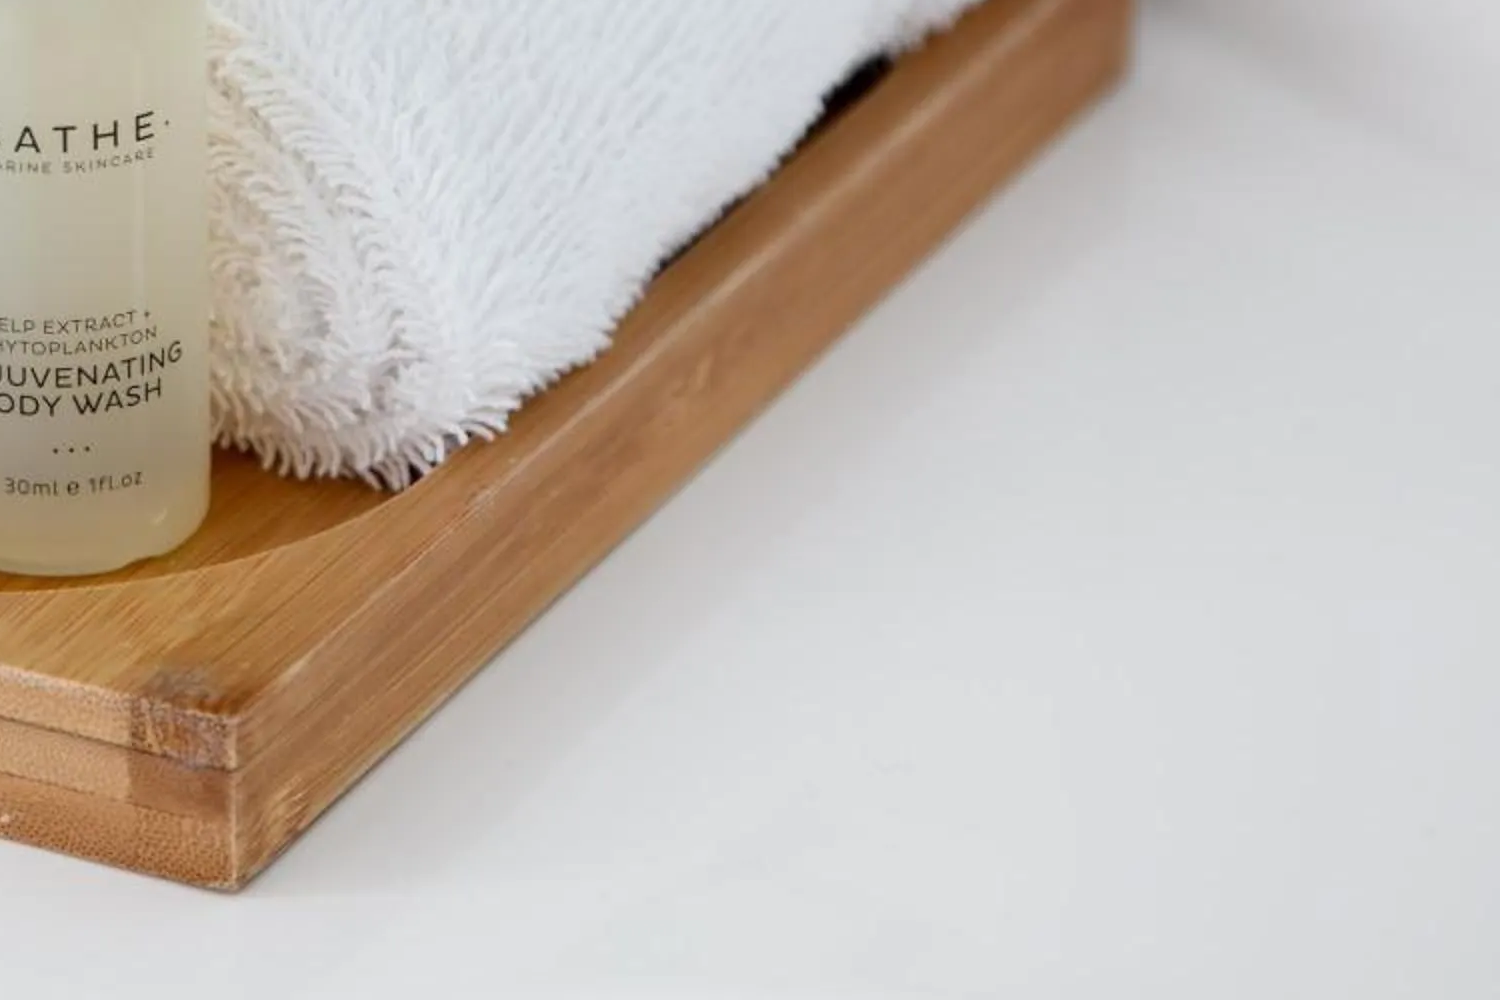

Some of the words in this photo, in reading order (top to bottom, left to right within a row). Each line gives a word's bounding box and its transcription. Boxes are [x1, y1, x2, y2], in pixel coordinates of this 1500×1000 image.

[62, 147, 155, 174] SKINCARE
[43, 309, 138, 335] EXTRACT
[72, 376, 162, 416] WASH
[4, 476, 59, 497] 30ml
